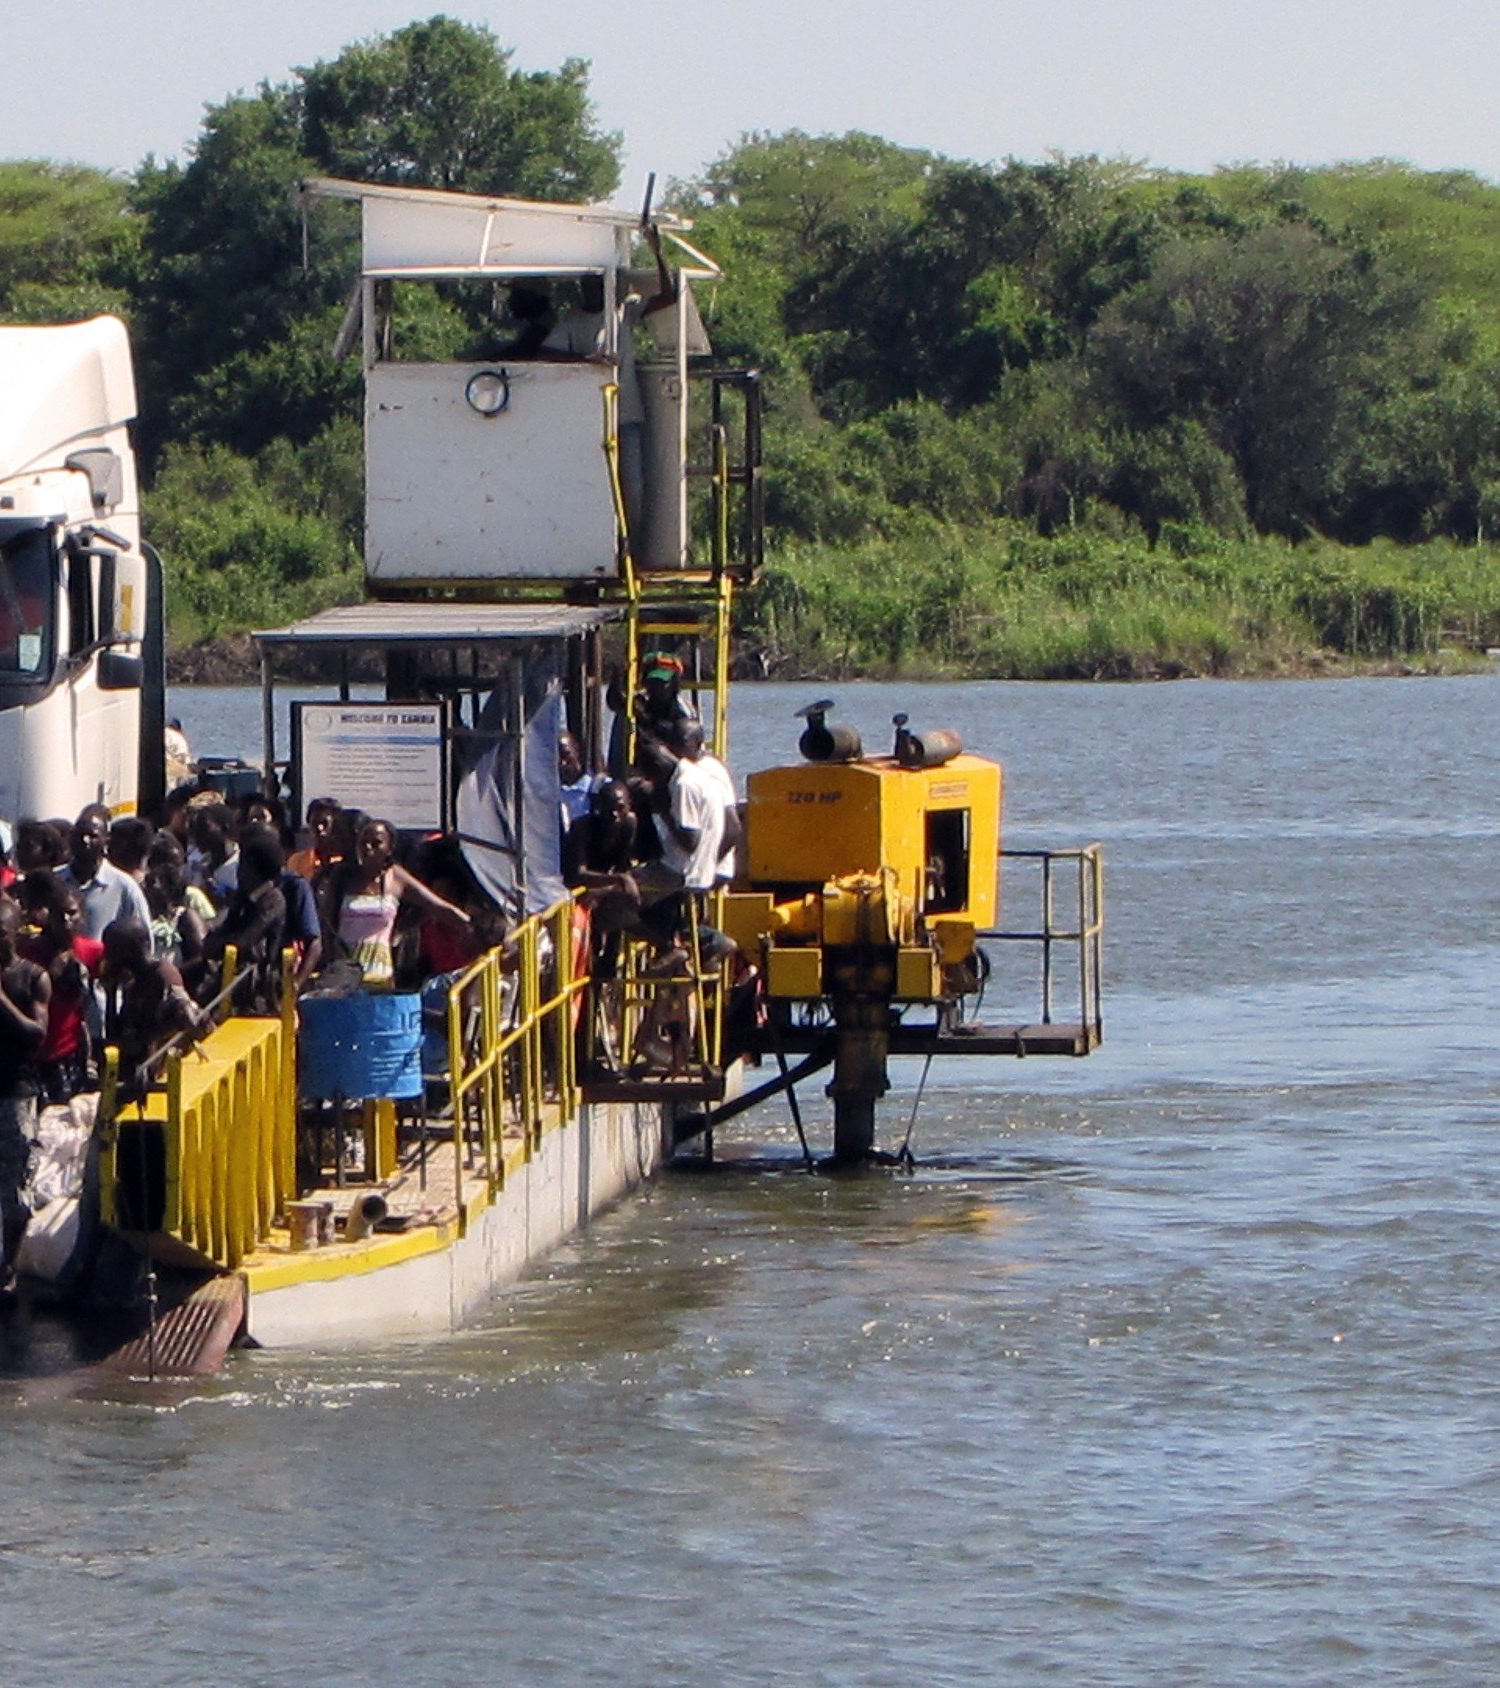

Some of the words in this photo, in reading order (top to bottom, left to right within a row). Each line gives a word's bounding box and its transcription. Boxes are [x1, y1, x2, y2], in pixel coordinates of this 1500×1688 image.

[341, 714, 384, 724] WELCOME
[387, 714, 399, 724] TO
[401, 714, 435, 724] ZAMBIA
